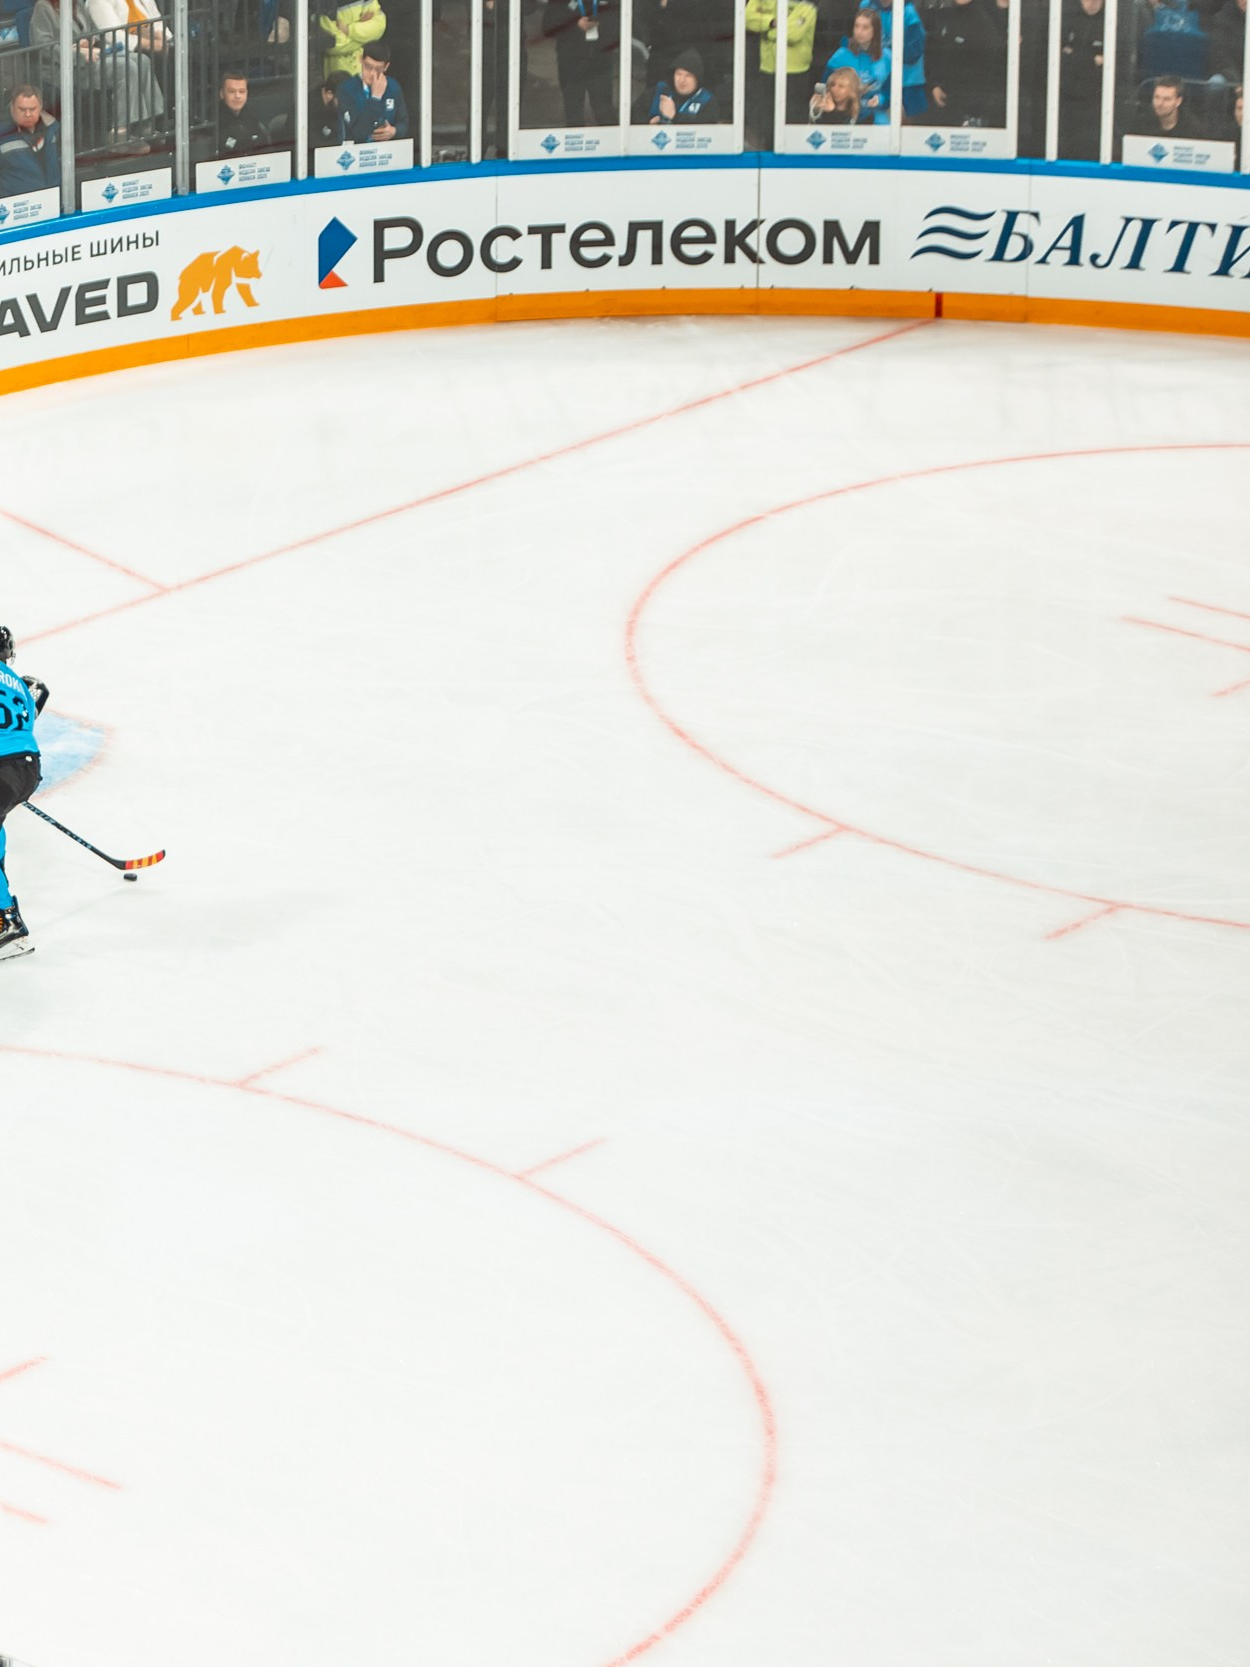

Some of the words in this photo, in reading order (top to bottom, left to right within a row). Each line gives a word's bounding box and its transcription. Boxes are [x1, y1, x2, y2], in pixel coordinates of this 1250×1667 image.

[89, 230, 160, 258] ШИНЫ
[373, 216, 881, 284] Ростелеком
[984, 209, 1250, 279] БАЛТИ
